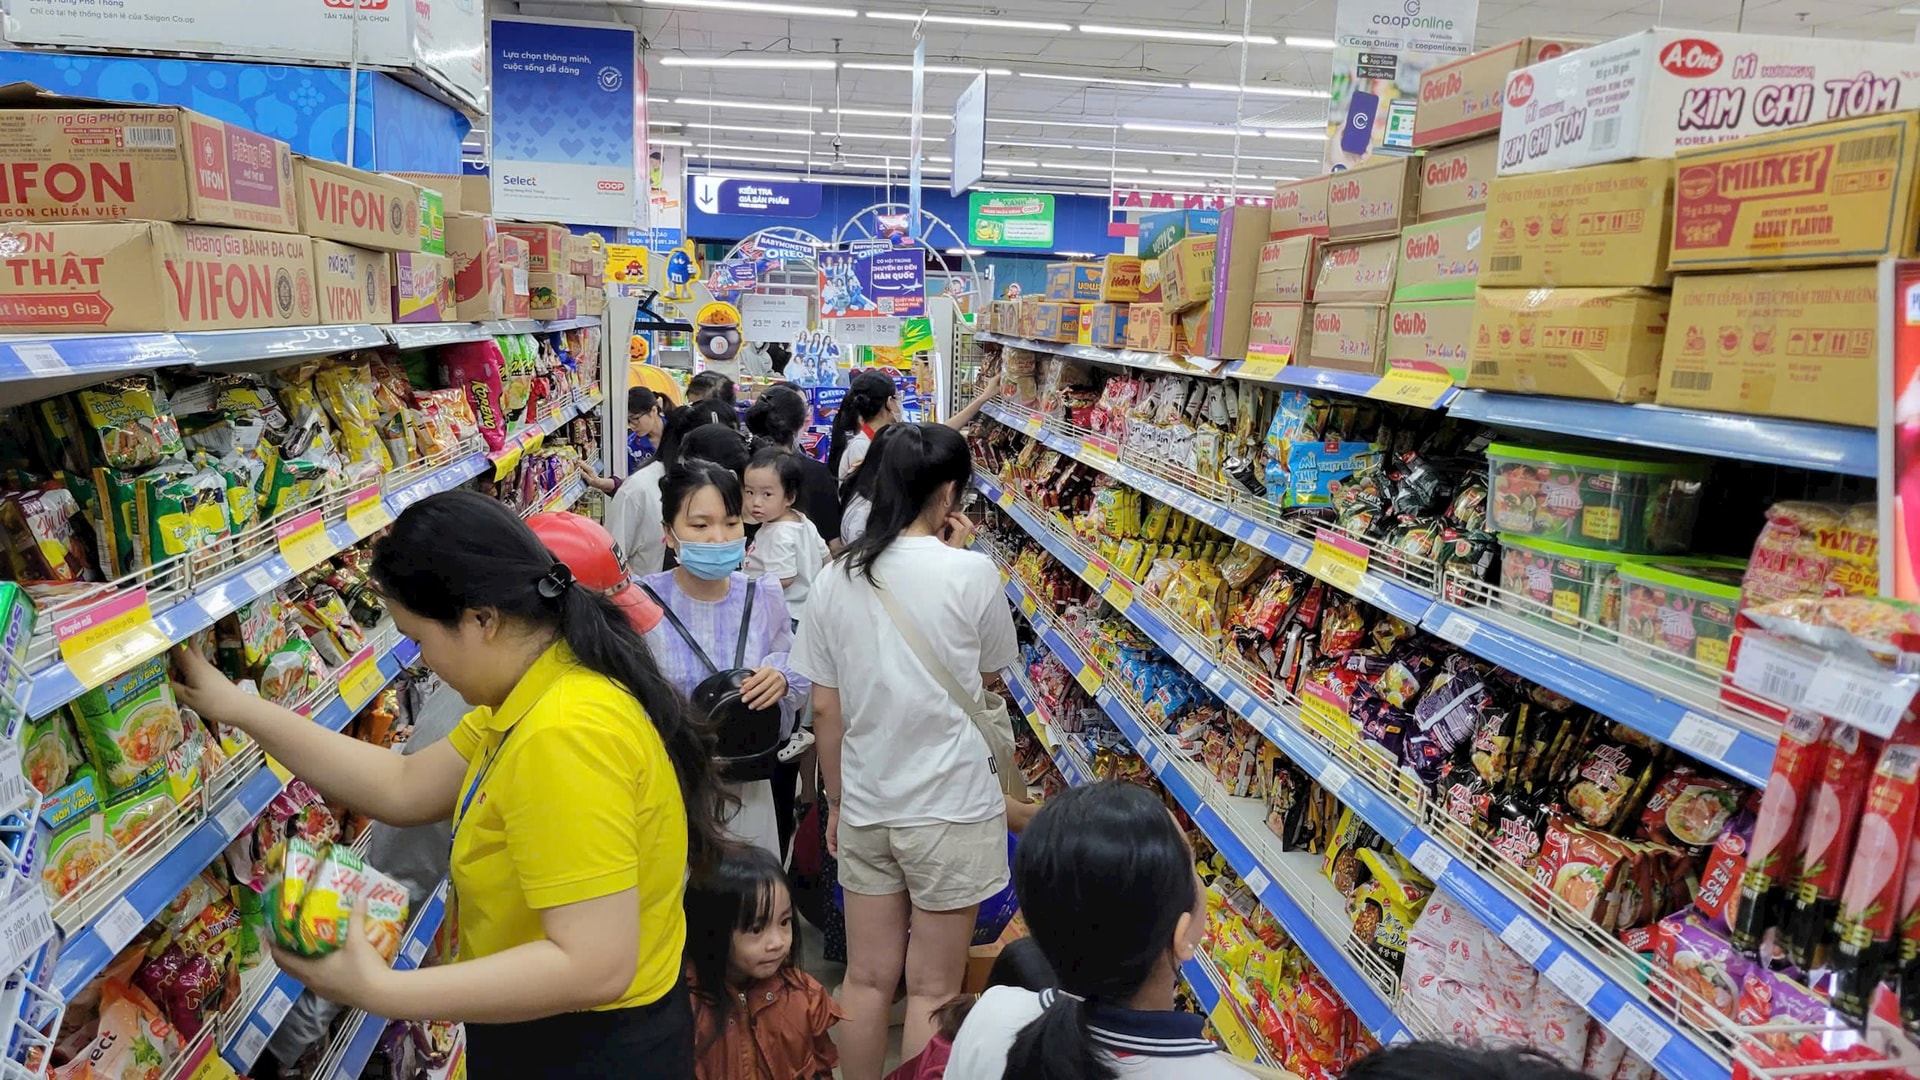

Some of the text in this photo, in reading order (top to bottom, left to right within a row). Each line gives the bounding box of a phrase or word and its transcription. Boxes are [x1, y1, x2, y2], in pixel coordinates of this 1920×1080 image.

[144, 14, 171, 23] Saigon
[1350, 38, 1400, 49] Co.op Online
[503, 49, 519, 61] Lựa
[521, 51, 542, 63] chọn
[543, 52, 568, 64] thông
[503, 62, 523, 73] cuộc
[524, 60, 545, 73] sống
[1675, 135, 1715, 146] KOREA
[199, 167, 225, 191] VIFON
[503, 174, 537, 187] Select
[598, 182, 624, 191] COOP
[758, 188, 773, 196] TRA
[95, 203, 128, 220] VIỆT
[309, 177, 386, 233] VIFON
[1789, 215, 1834, 237] FLAVOR
[185, 231, 223, 258] Hoàng
[223, 234, 242, 256] Gia
[286, 243, 304, 259] CUA
[760, 236, 813, 257] BABYMONSTER
[766, 249, 804, 261] OREO
[6, 251, 105, 292] THẬT
[163, 259, 274, 323] VIFON
[326, 286, 363, 322] VIFON
[752, 318, 763, 328] 23
[781, 320, 791, 329] 21
[845, 323, 857, 331] 23
[876, 324, 887, 333] 35
[60, 619, 82, 636] Khuyến
[81, 616, 93, 628] mãi
